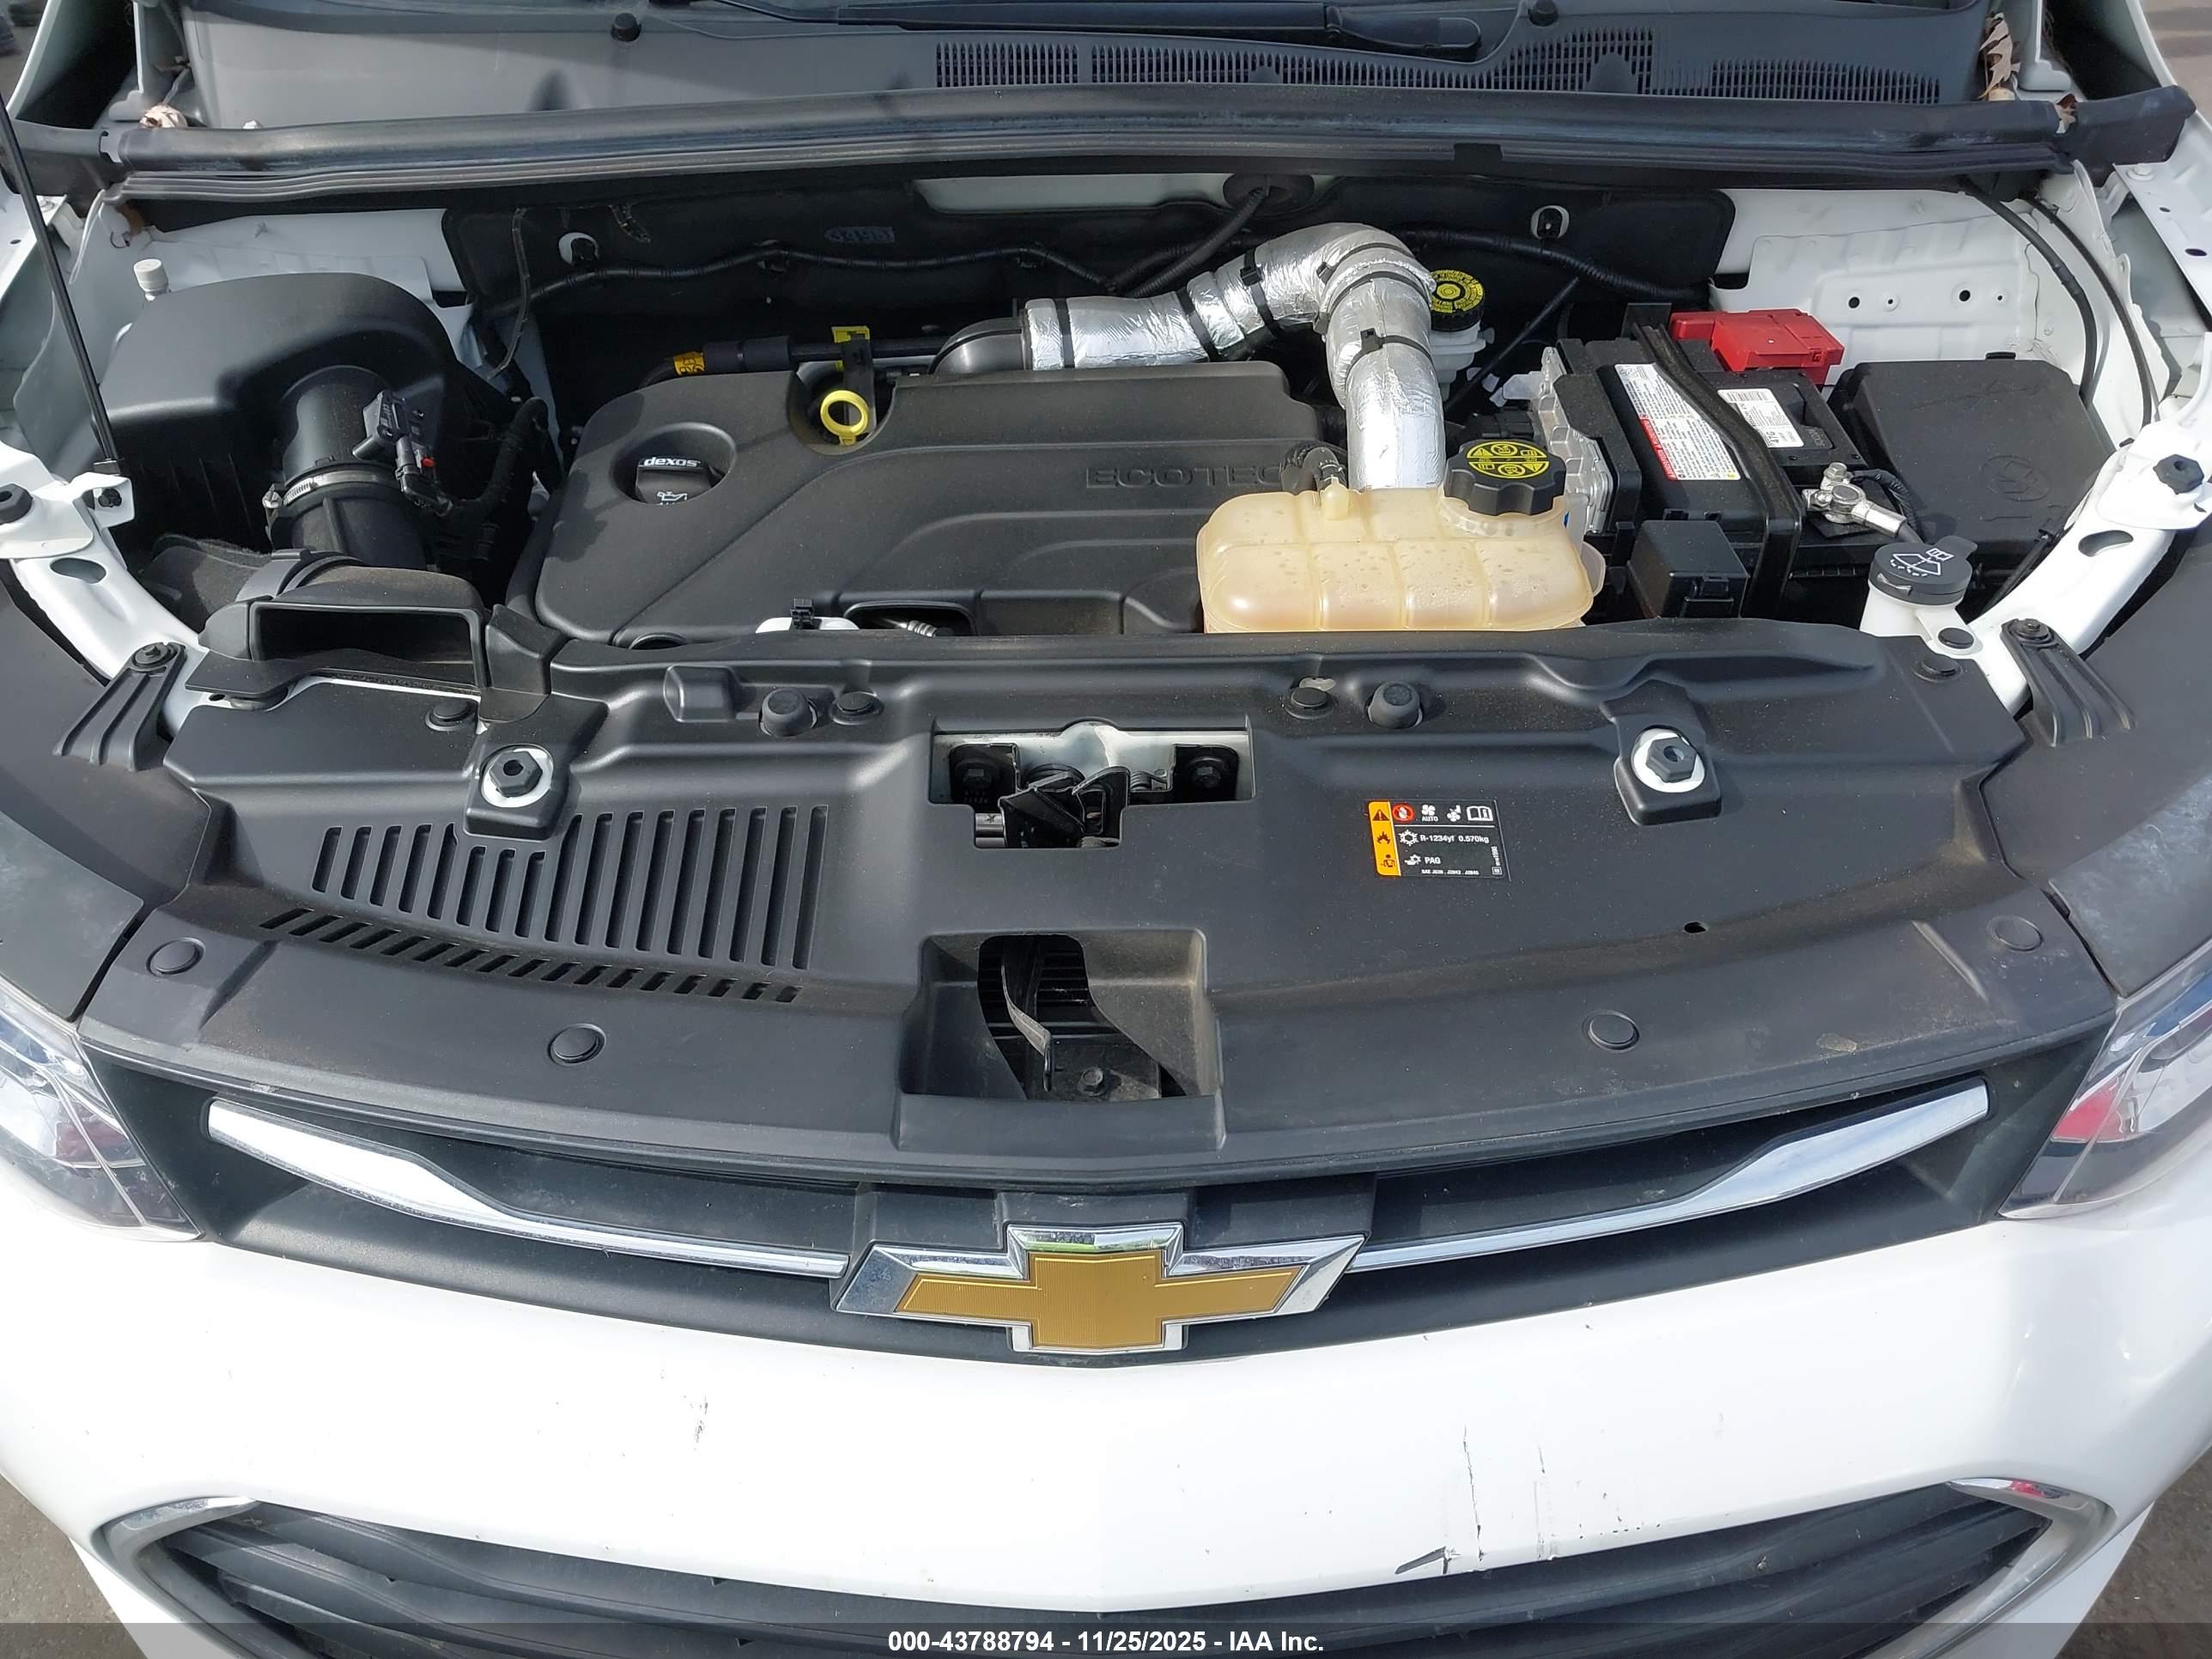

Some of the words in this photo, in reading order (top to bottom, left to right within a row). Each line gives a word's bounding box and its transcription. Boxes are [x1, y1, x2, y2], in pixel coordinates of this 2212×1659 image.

[644, 457, 698, 467] dexos
[1086, 465, 1281, 488] ECOTEC
[1458, 835, 1489, 844] 0.570kg
